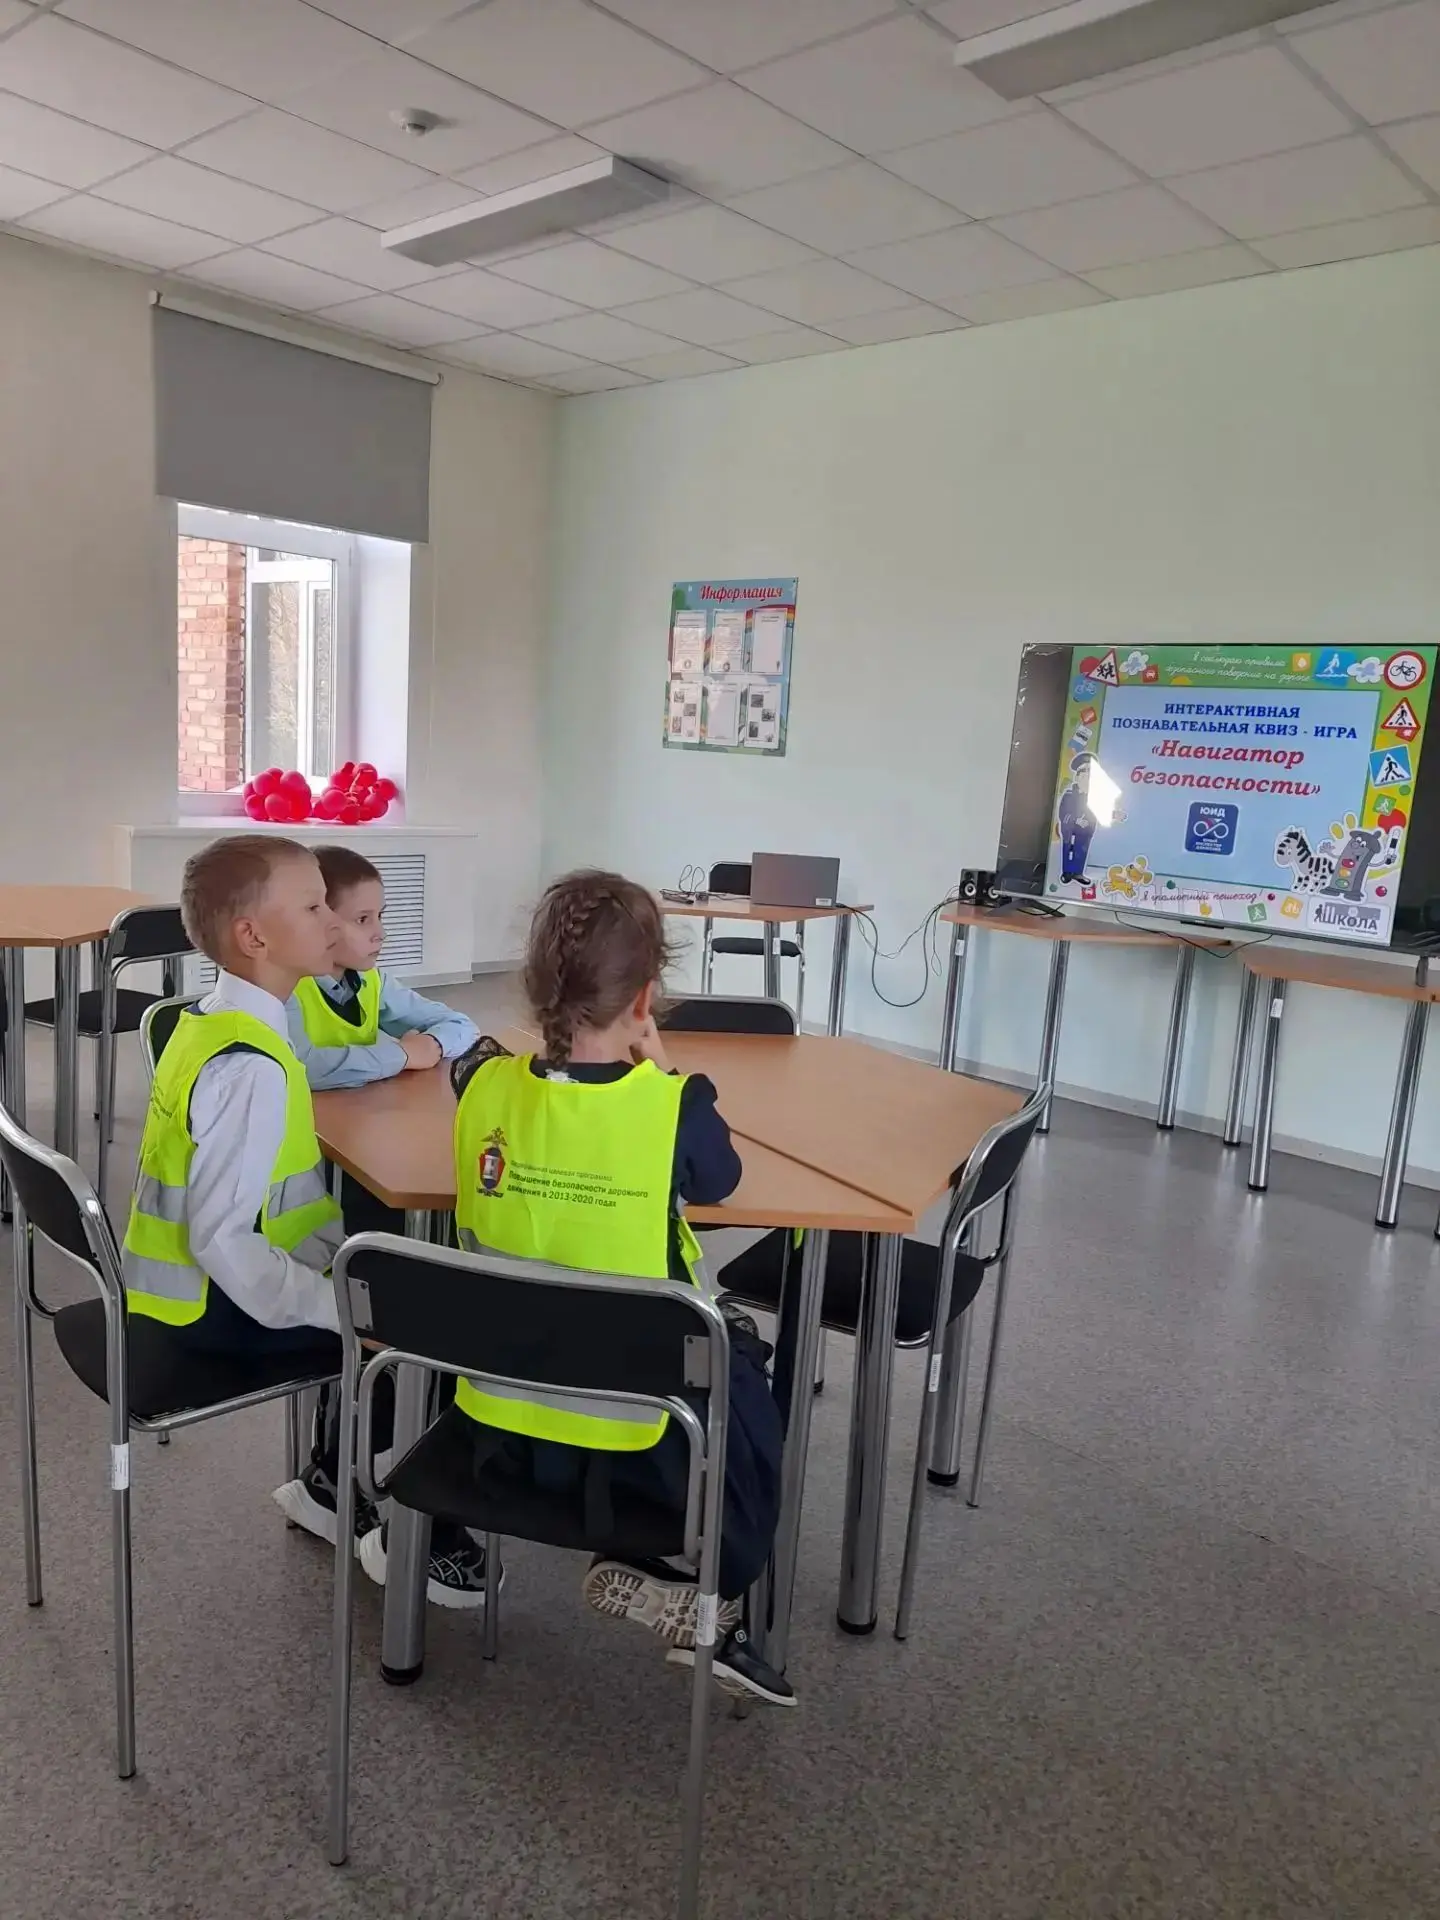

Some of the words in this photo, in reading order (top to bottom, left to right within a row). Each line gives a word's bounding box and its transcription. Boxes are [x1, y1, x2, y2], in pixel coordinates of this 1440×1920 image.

[701, 585, 783, 603] Информация
[1163, 702, 1301, 719] ИНТЕРАКТИВНАЯ
[1112, 717, 1250, 735] ПОЗНАВАТЕЛЬНАЯ
[1254, 723, 1299, 737] КВИЗ
[1313, 725, 1358, 740] ИГРА
[1151, 739, 1305, 770] «Навигатор
[1129, 766, 1322, 797] безопасности»
[1200, 806, 1226, 818] ЮИД
[1320, 902, 1378, 931] ШКОЛА
[507, 1184, 541, 1196] движения
[548, 1190, 593, 1205] 2013-2020
[595, 1198, 617, 1208] годах
[509, 1170, 551, 1187] Повышение
[607, 1187, 649, 1199] дорожного
